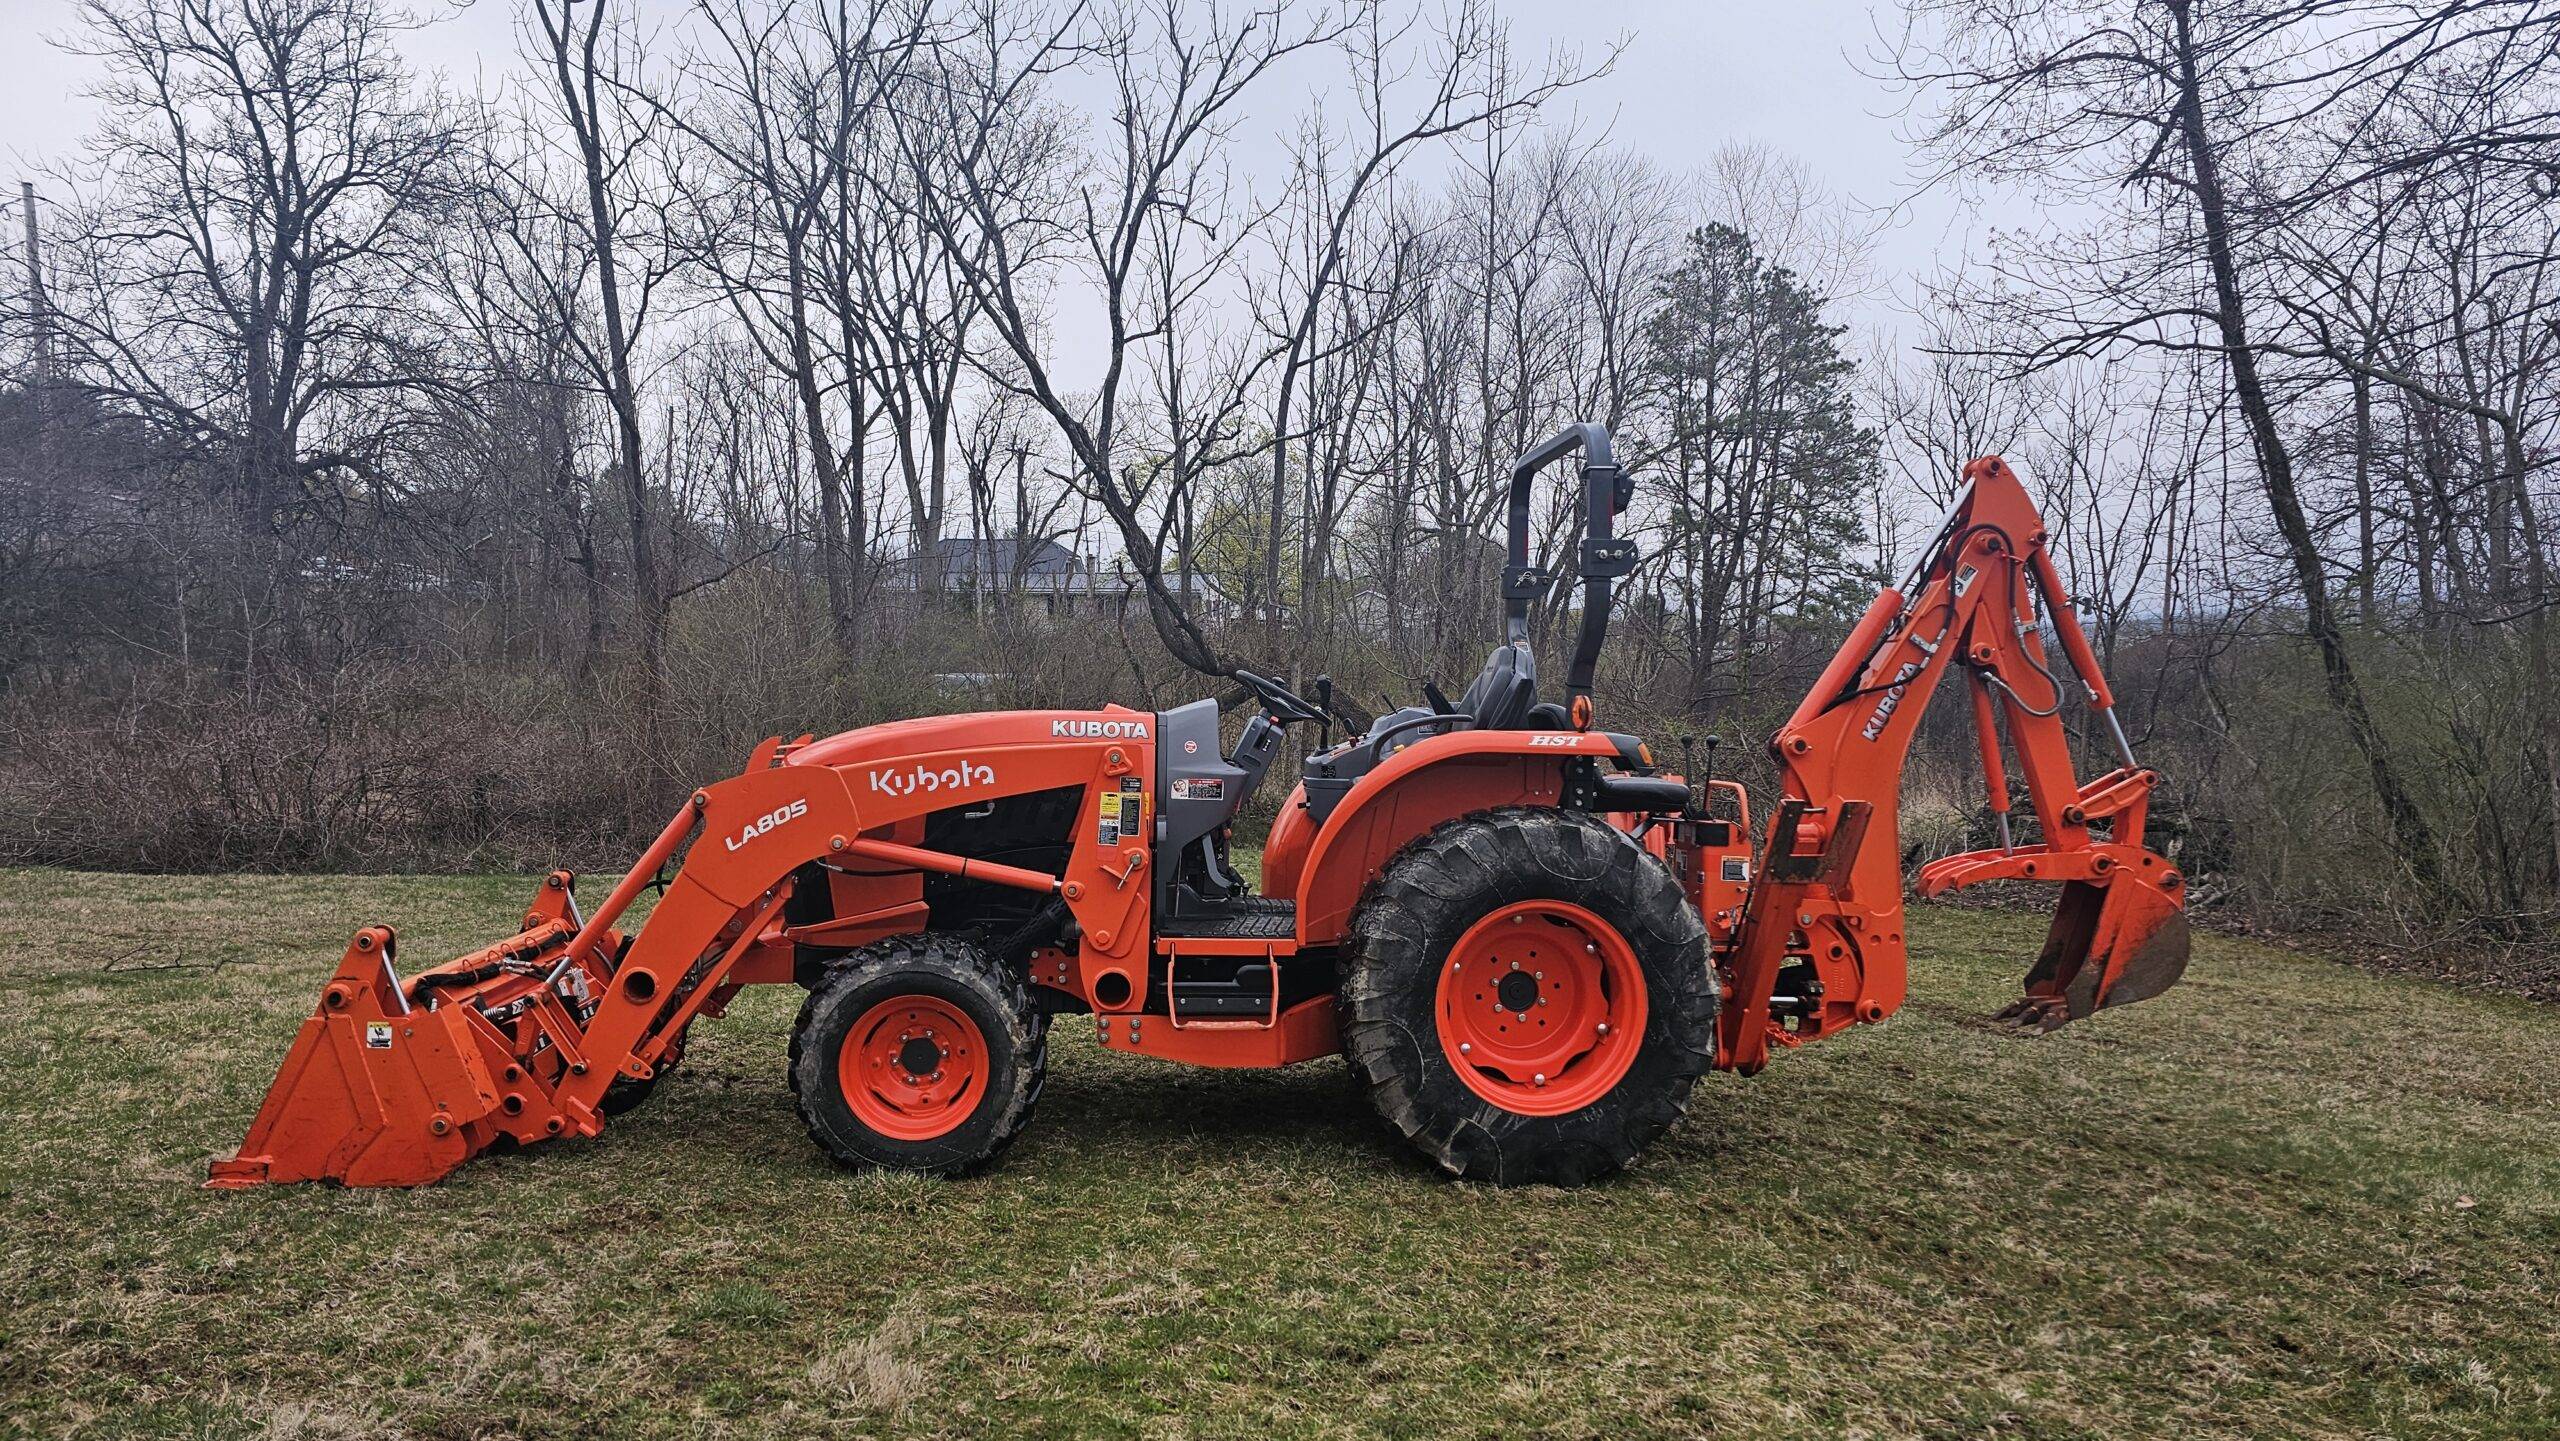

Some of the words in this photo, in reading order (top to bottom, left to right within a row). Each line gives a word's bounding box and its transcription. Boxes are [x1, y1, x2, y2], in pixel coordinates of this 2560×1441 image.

[1052, 720, 1149, 739] KUBOTA
[1528, 735, 1584, 747] HST
[869, 760, 995, 796] Kubota
[725, 798, 808, 851] LA805
